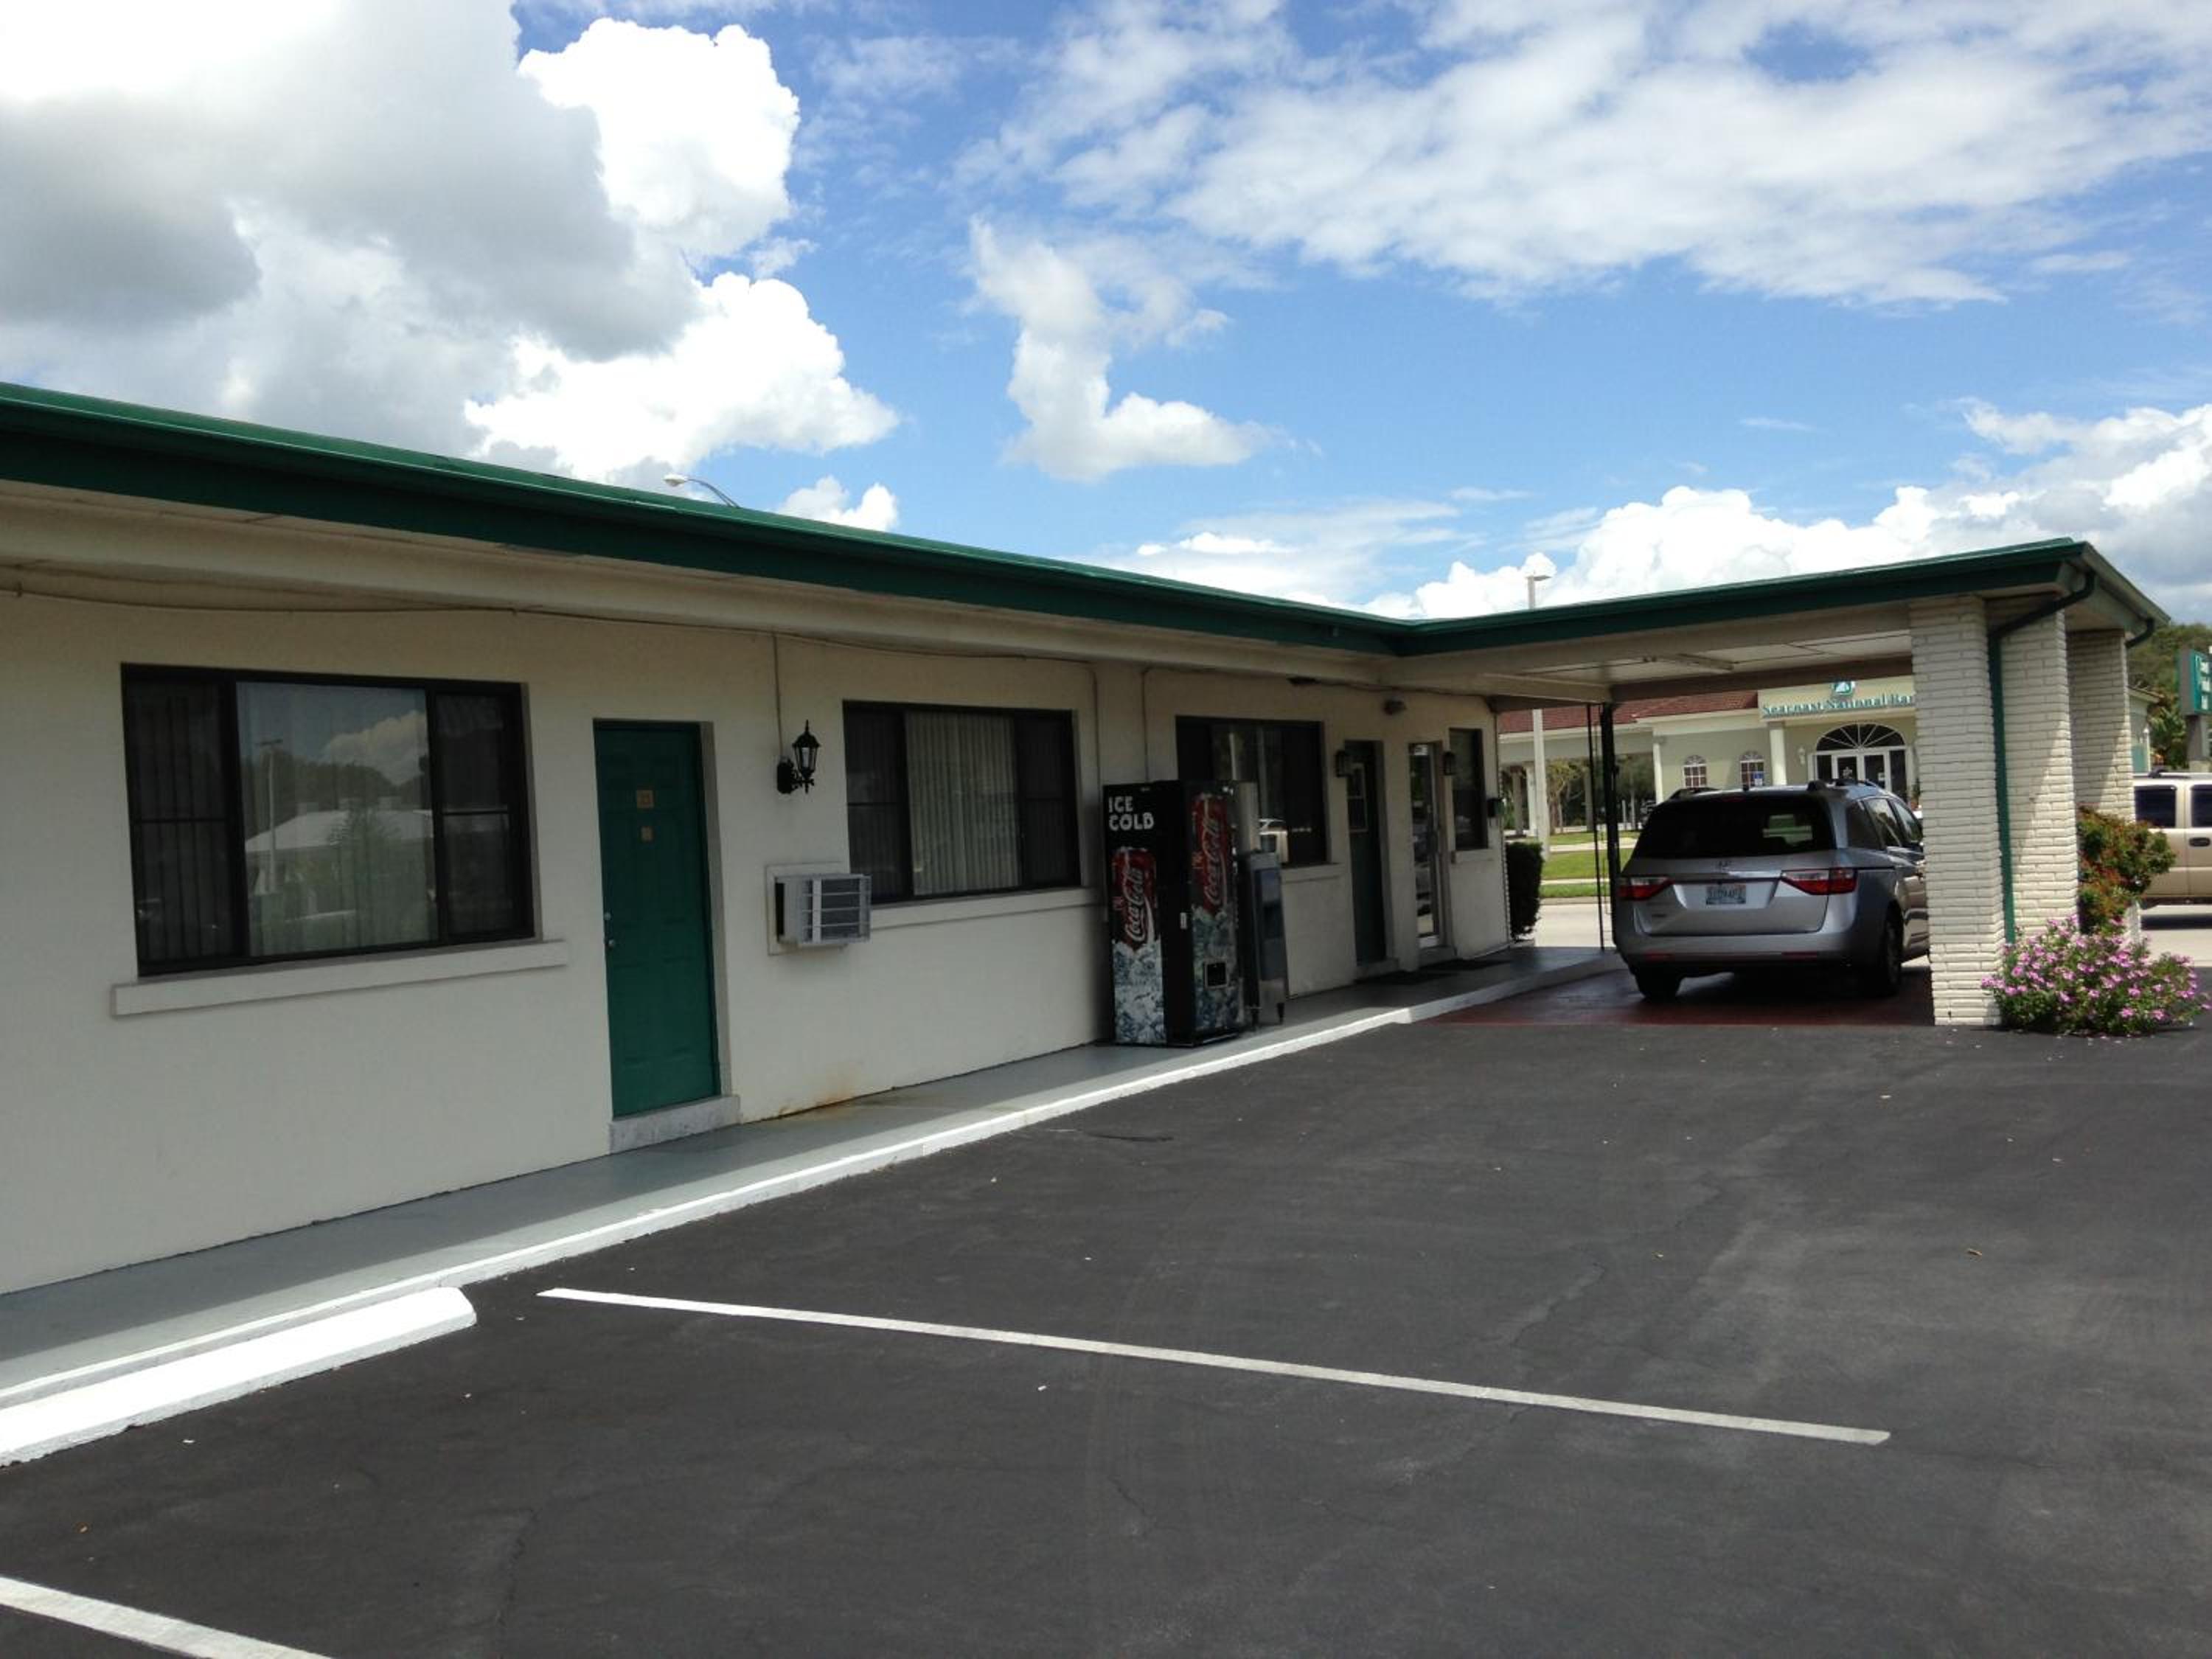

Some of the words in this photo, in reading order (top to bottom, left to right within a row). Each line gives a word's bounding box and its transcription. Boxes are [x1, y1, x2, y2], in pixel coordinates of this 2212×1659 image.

[1826, 694, 1886, 709] National
[1891, 692, 1913, 706] Ba
[1108, 796, 1133, 813] ICE
[1108, 812, 1155, 831] COLD
